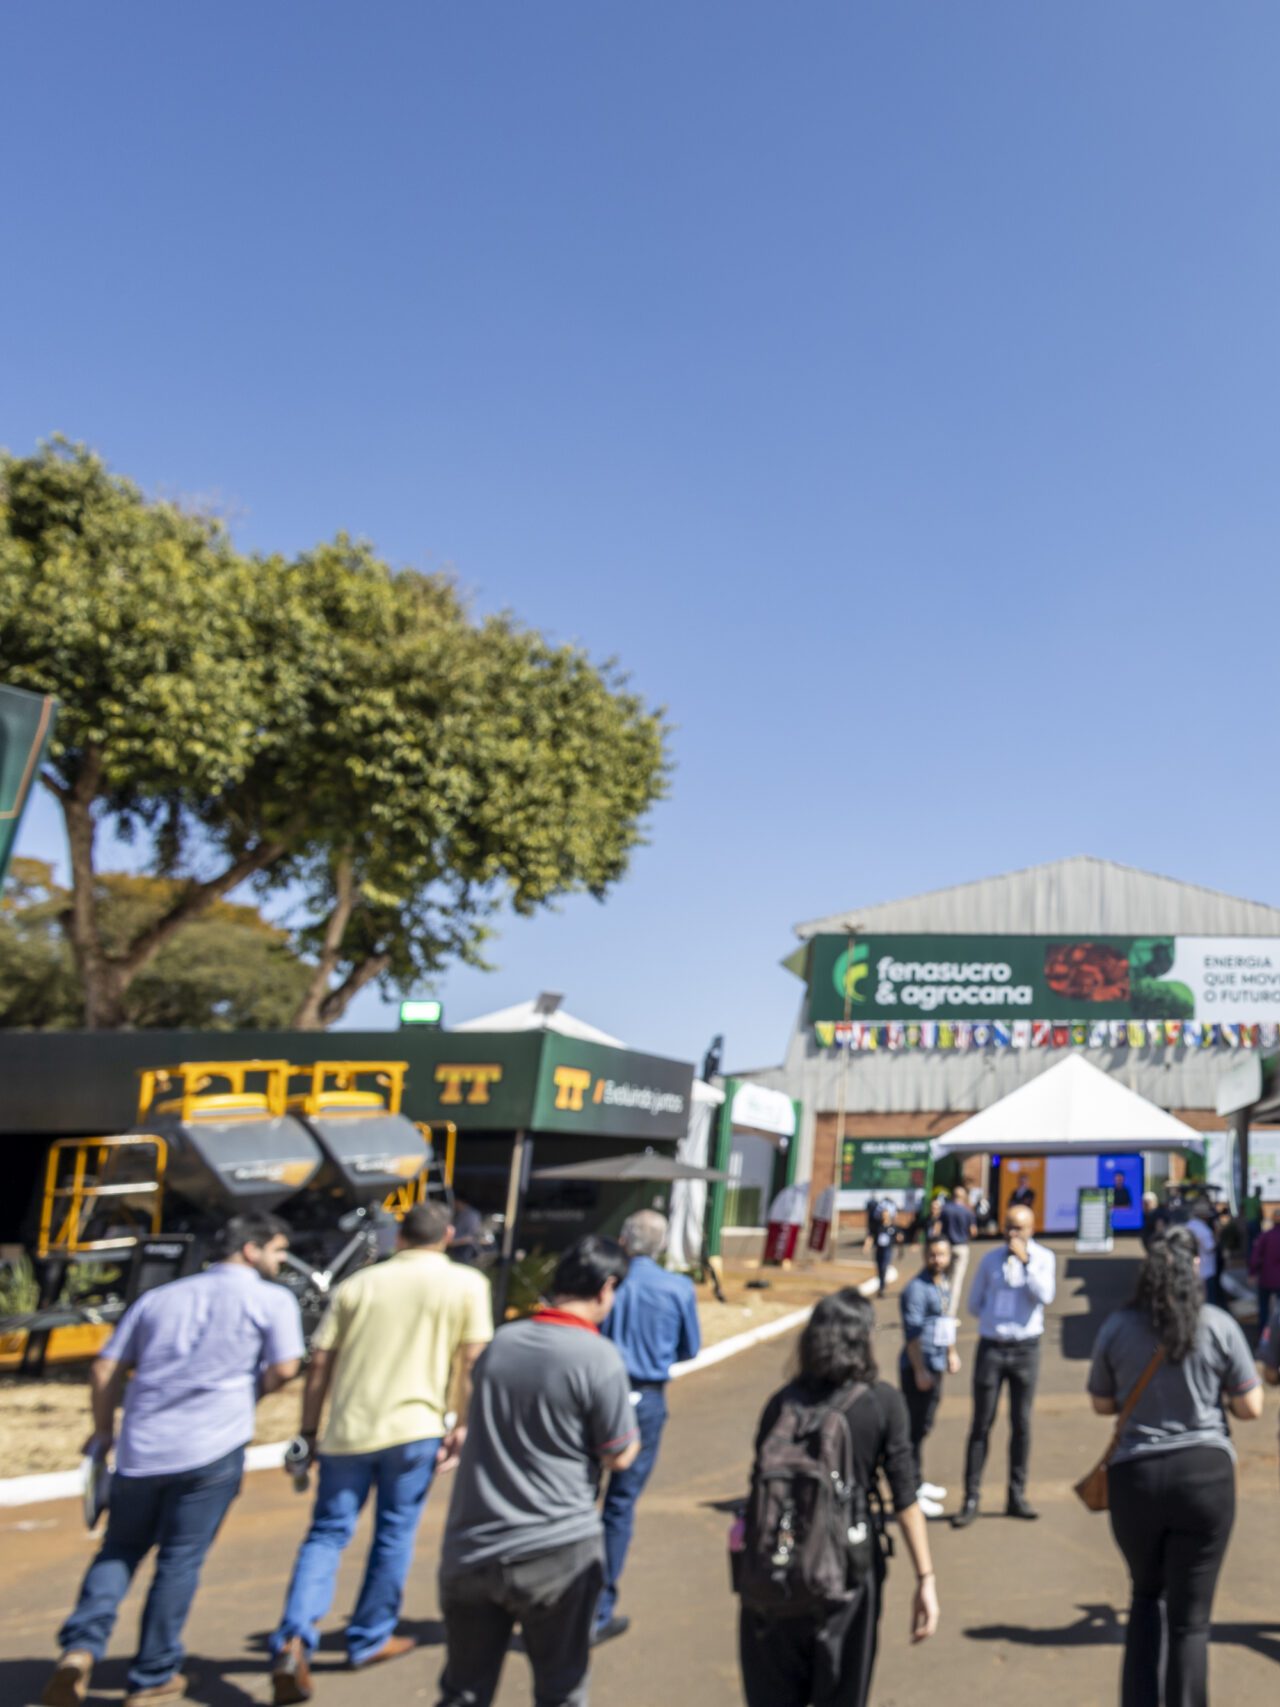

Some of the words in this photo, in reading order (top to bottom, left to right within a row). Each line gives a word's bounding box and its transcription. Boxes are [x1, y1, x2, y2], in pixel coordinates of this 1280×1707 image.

[877, 956, 1012, 982] fenasucro
[1204, 956, 1272, 968] ENERGIA
[1204, 973, 1235, 987] QUE
[875, 981, 897, 1004] &
[901, 986, 1032, 1010] agrocana
[1204, 990, 1217, 1003] O
